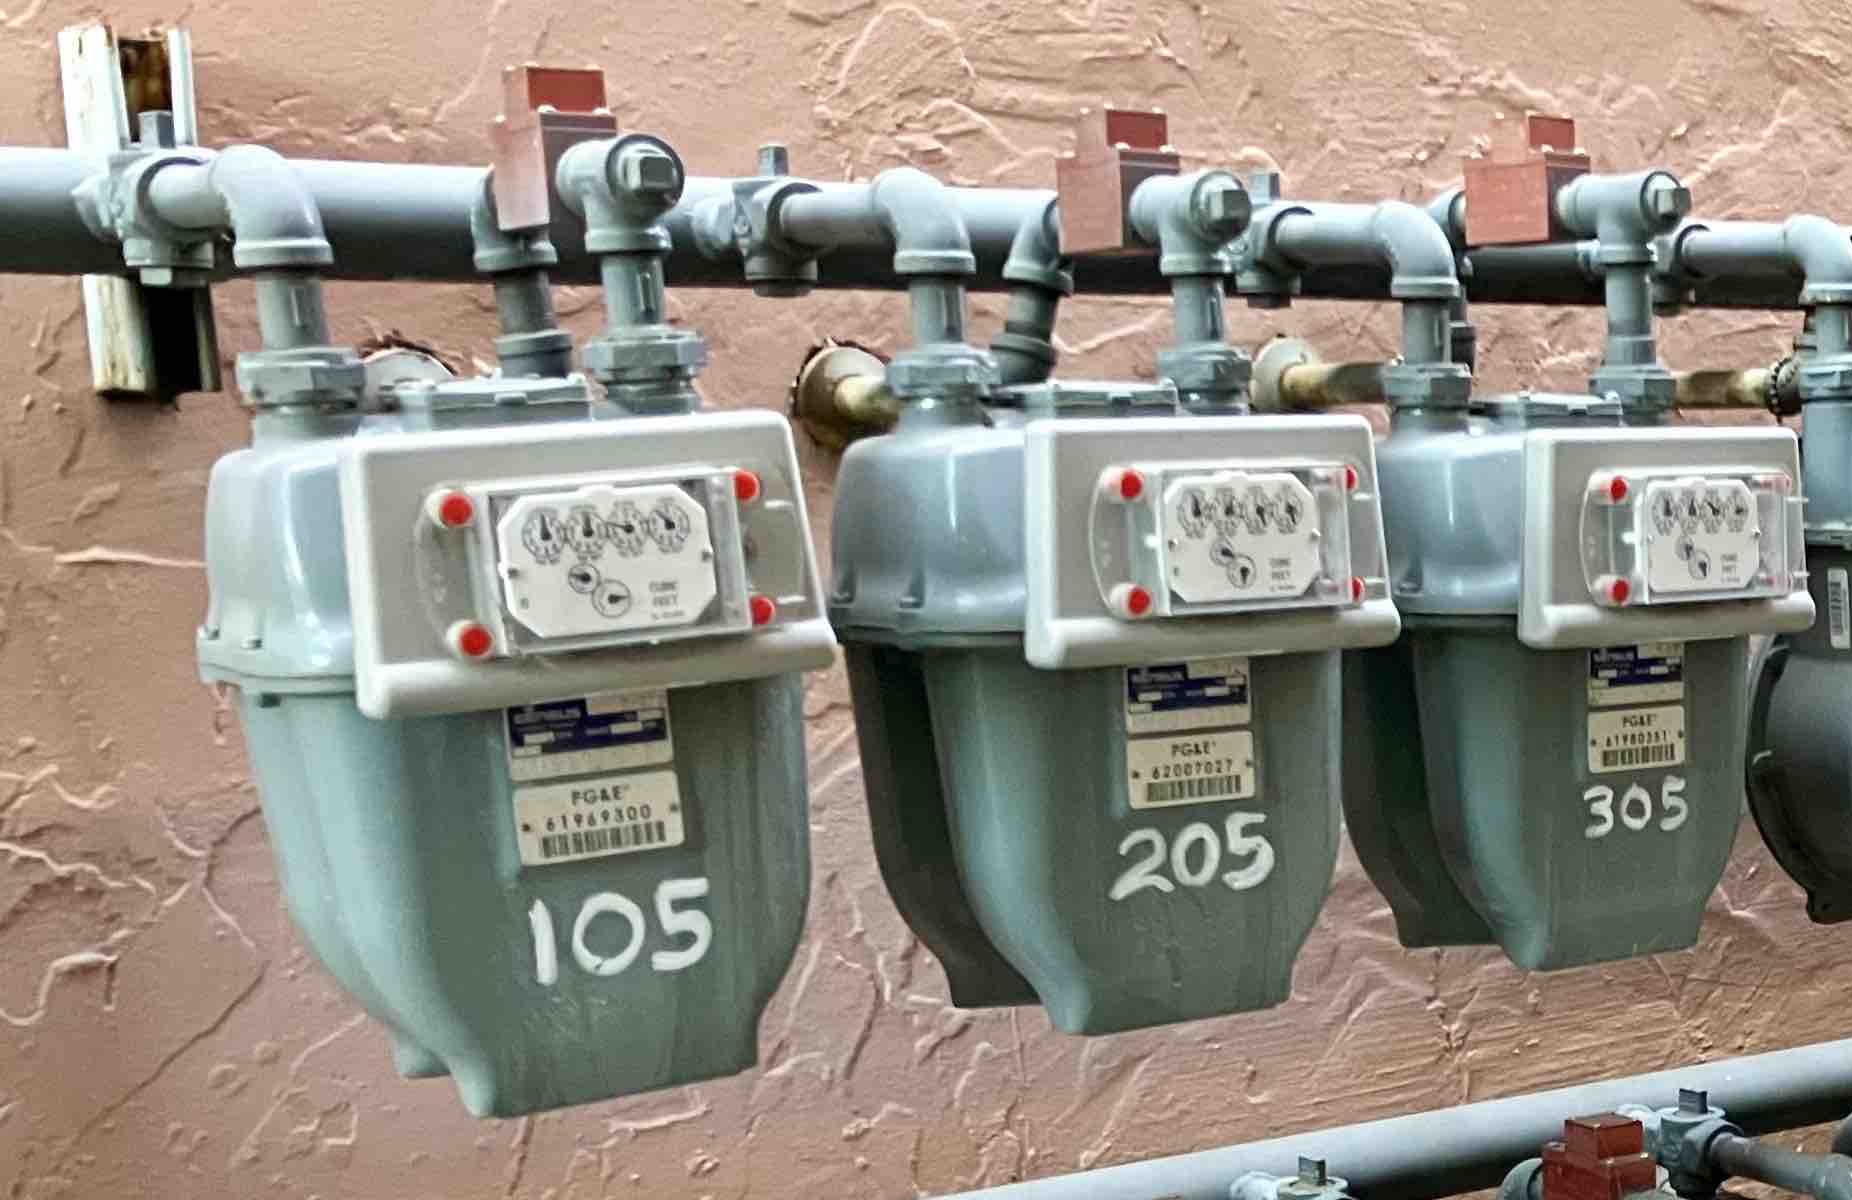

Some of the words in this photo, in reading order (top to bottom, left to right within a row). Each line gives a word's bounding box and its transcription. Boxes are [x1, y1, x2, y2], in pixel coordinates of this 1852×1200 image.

[1622, 714, 1653, 728] PG&E
[1171, 741, 1212, 757] PG&E
[571, 785, 624, 806] PG&E
[1584, 775, 1688, 839] 305
[546, 804, 652, 831] 61969300
[1109, 812, 1275, 900] 205
[528, 877, 712, 985] 105
